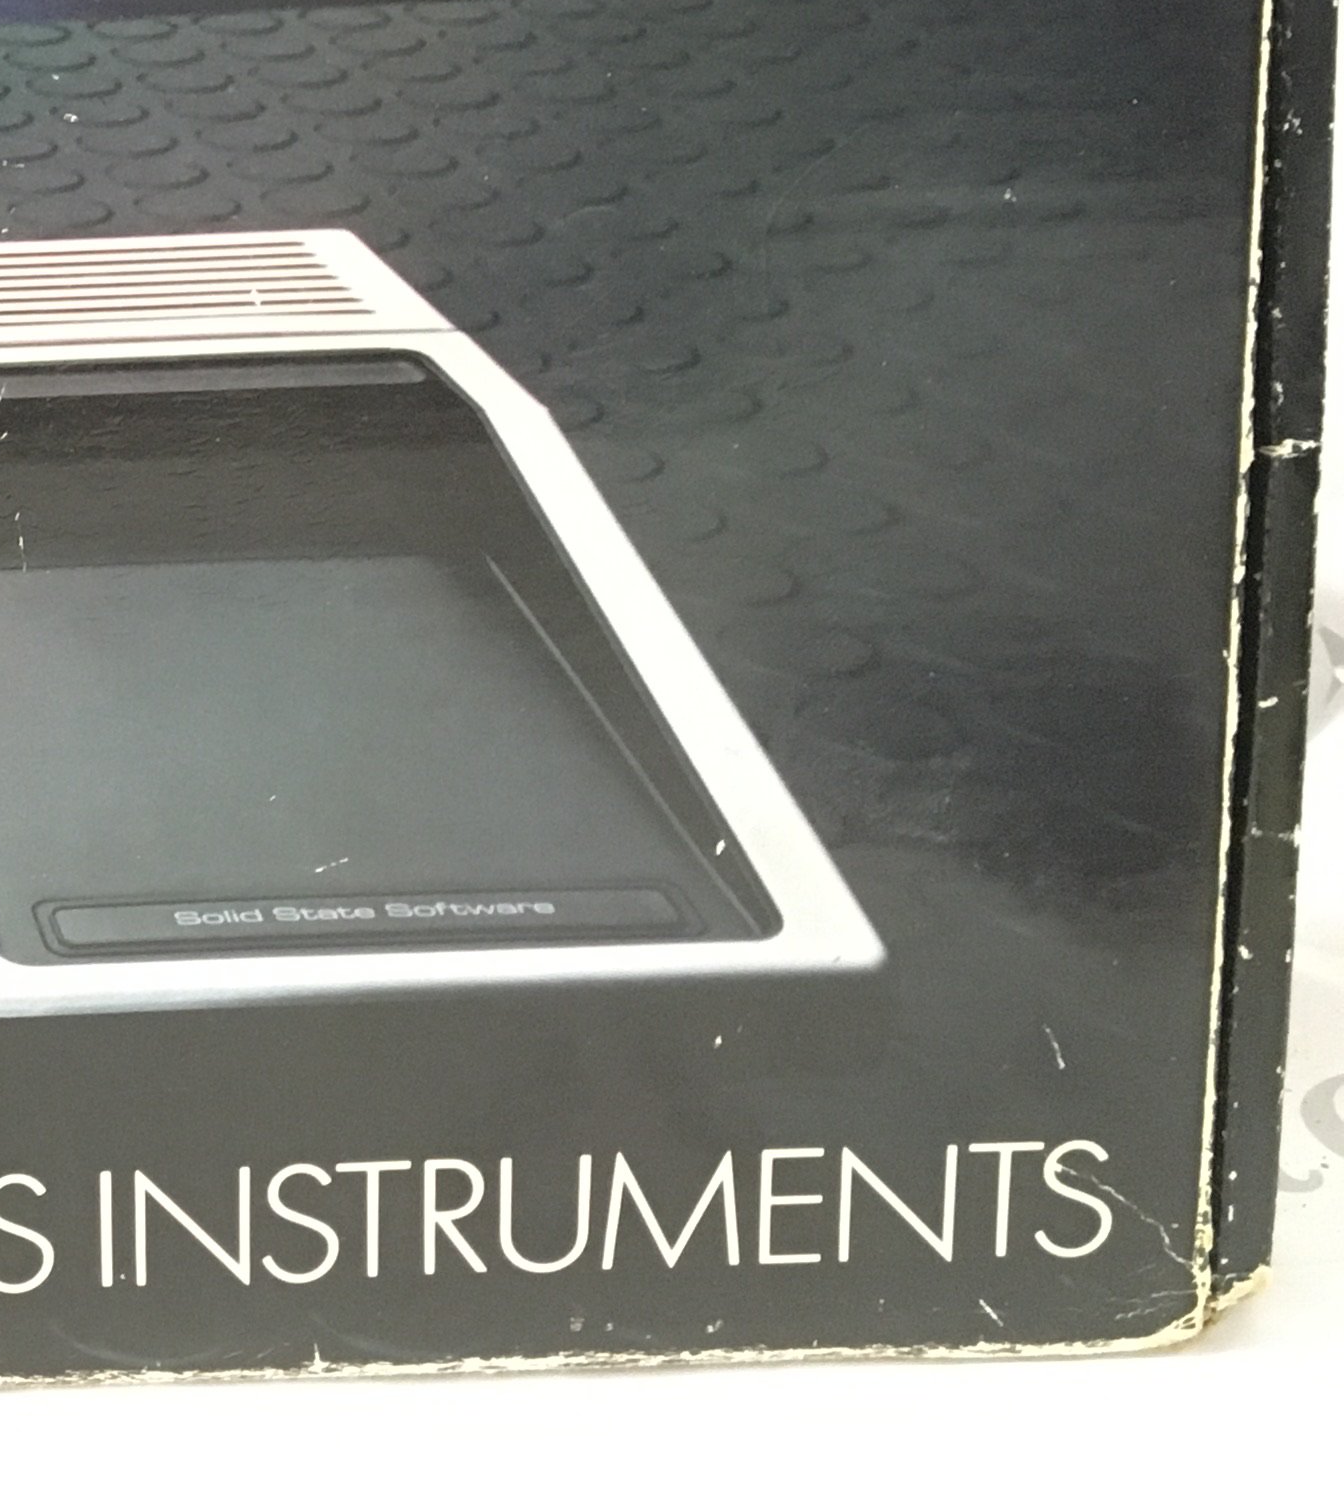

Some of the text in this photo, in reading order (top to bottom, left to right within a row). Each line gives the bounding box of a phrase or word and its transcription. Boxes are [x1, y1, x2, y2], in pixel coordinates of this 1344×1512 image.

[174, 900, 555, 926] Solid State Software
[100, 1139, 1113, 1287] INSTRUMENTS
